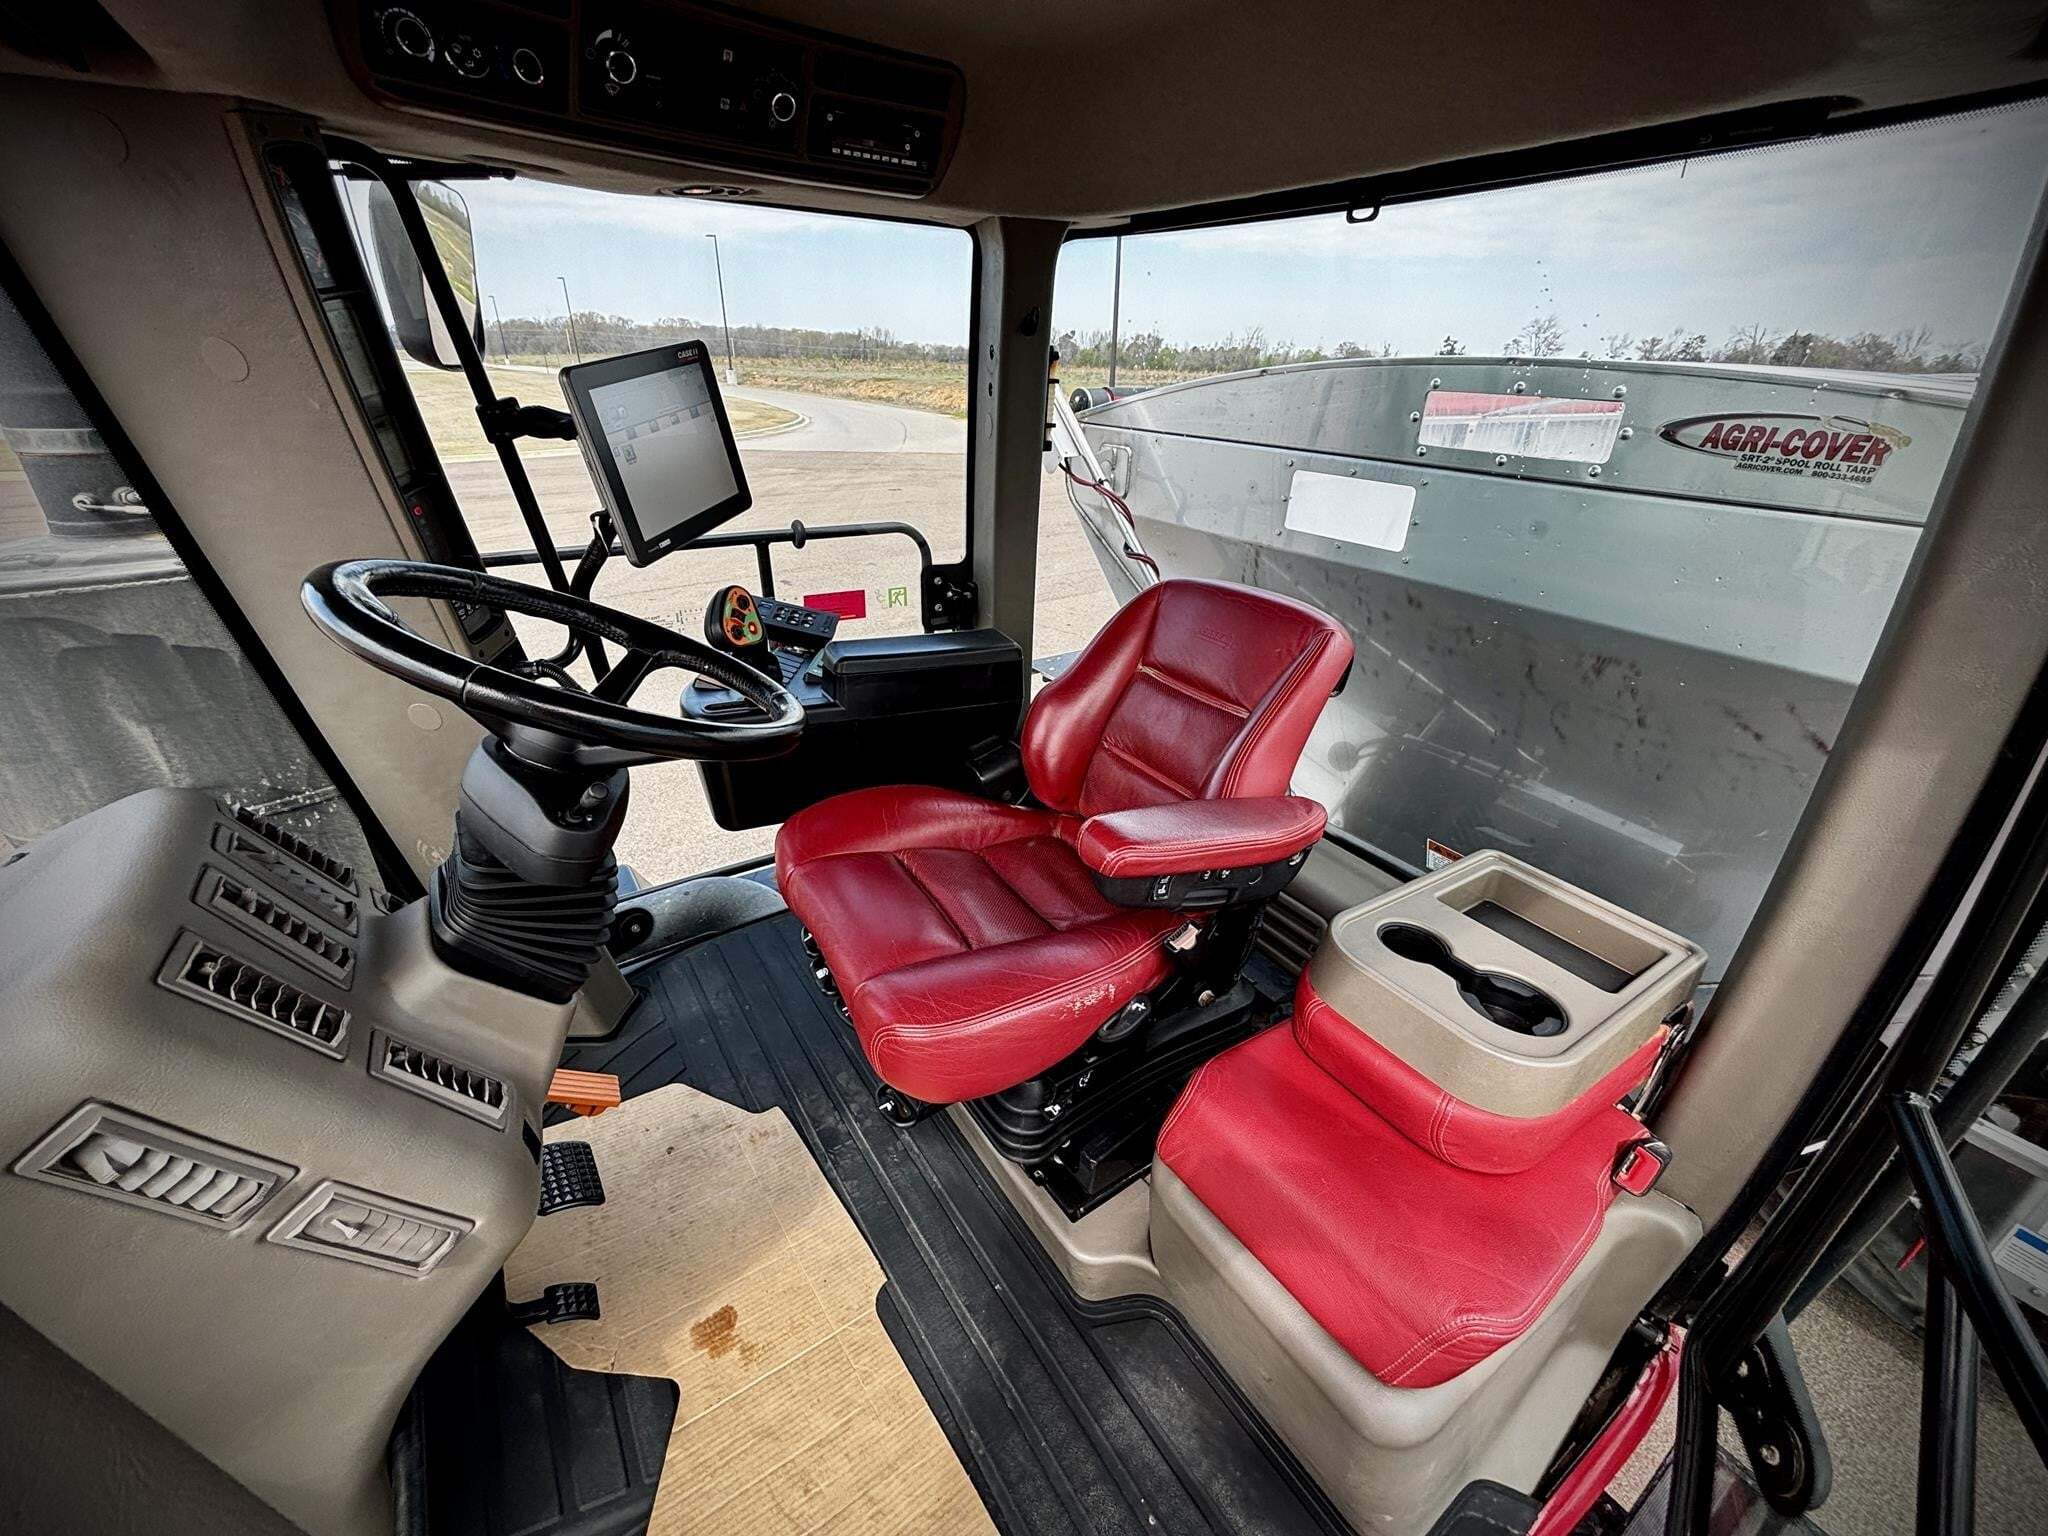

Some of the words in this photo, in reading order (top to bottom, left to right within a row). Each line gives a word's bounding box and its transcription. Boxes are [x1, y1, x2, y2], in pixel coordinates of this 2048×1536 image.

[1699, 423, 1892, 466] AGRI-COVER
[1736, 463, 1803, 476] AGRICOVER.COM
[1775, 457, 1810, 469] SPOOL
[1813, 461, 1842, 473] ROLL
[1846, 464, 1876, 476] TARP
